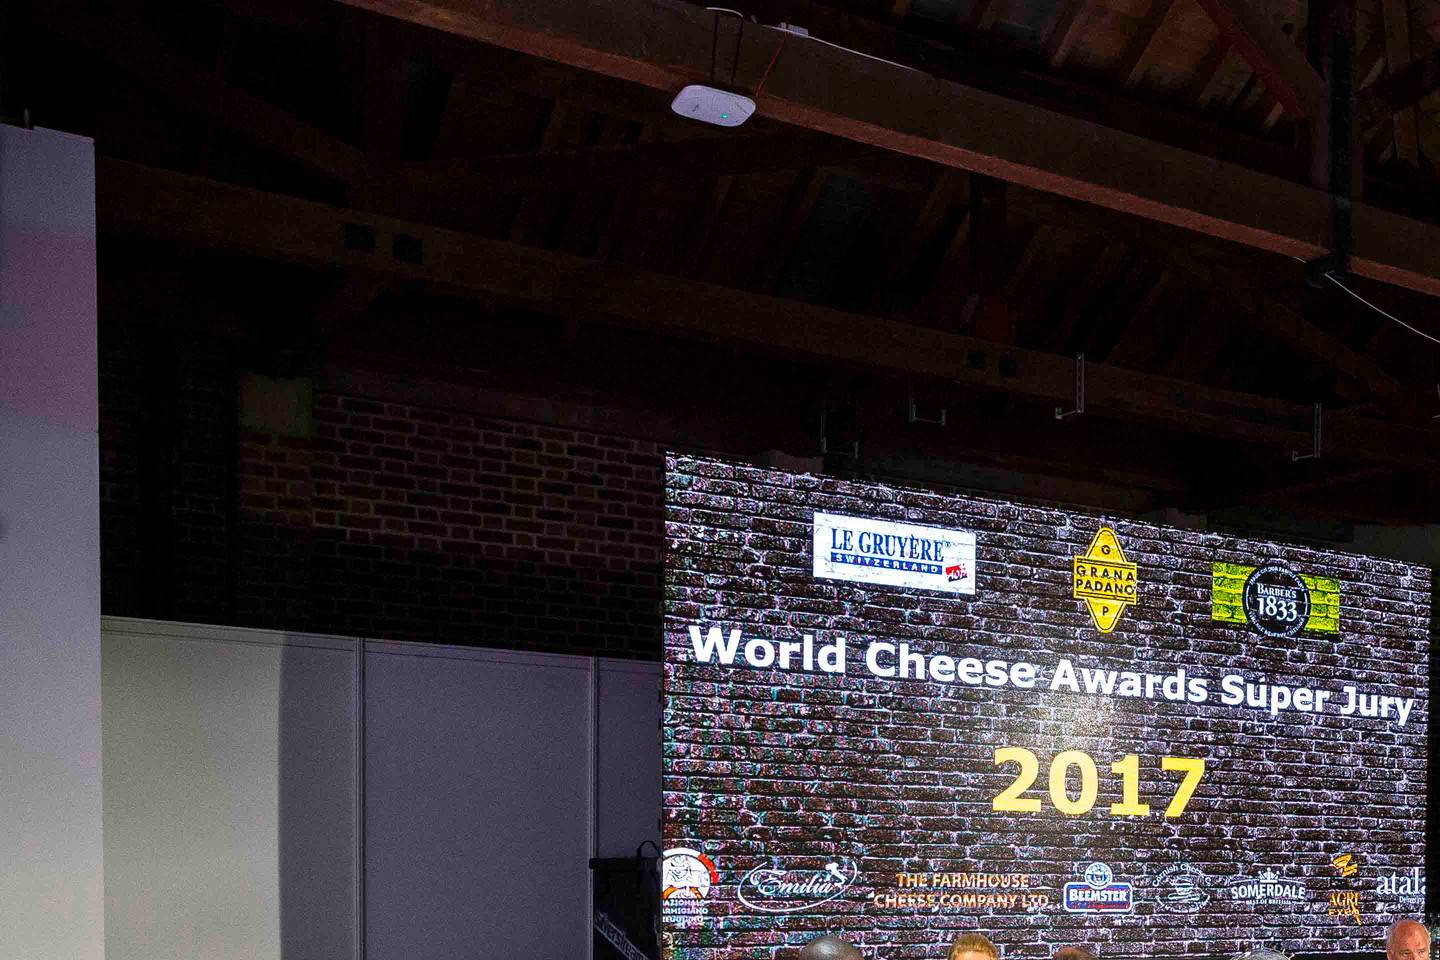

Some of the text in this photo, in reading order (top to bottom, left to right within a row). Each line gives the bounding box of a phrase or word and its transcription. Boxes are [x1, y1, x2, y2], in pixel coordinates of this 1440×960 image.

[831, 528, 853, 551] LE
[1101, 545, 1111, 555] G
[835, 553, 938, 573] SWITZERLAND
[1076, 565, 1134, 582] GRANA
[1076, 578, 1135, 595] PADANO
[1257, 583, 1297, 599] BARBER'S
[1102, 606, 1109, 616] P
[1257, 596, 1298, 622] 1833
[688, 624, 1414, 726] World Cheese Awards Super Jury
[992, 746, 1205, 818] 2017
[896, 872, 1030, 888] THE FARMHOUSE
[1152, 864, 1179, 887] Cornish
[1069, 888, 1127, 902] BEEMSTER
[1231, 884, 1306, 900] SOMERDALE
[1329, 890, 1360, 907] AGRI
[873, 893, 1049, 909] CHEESE COMPANY LTD
